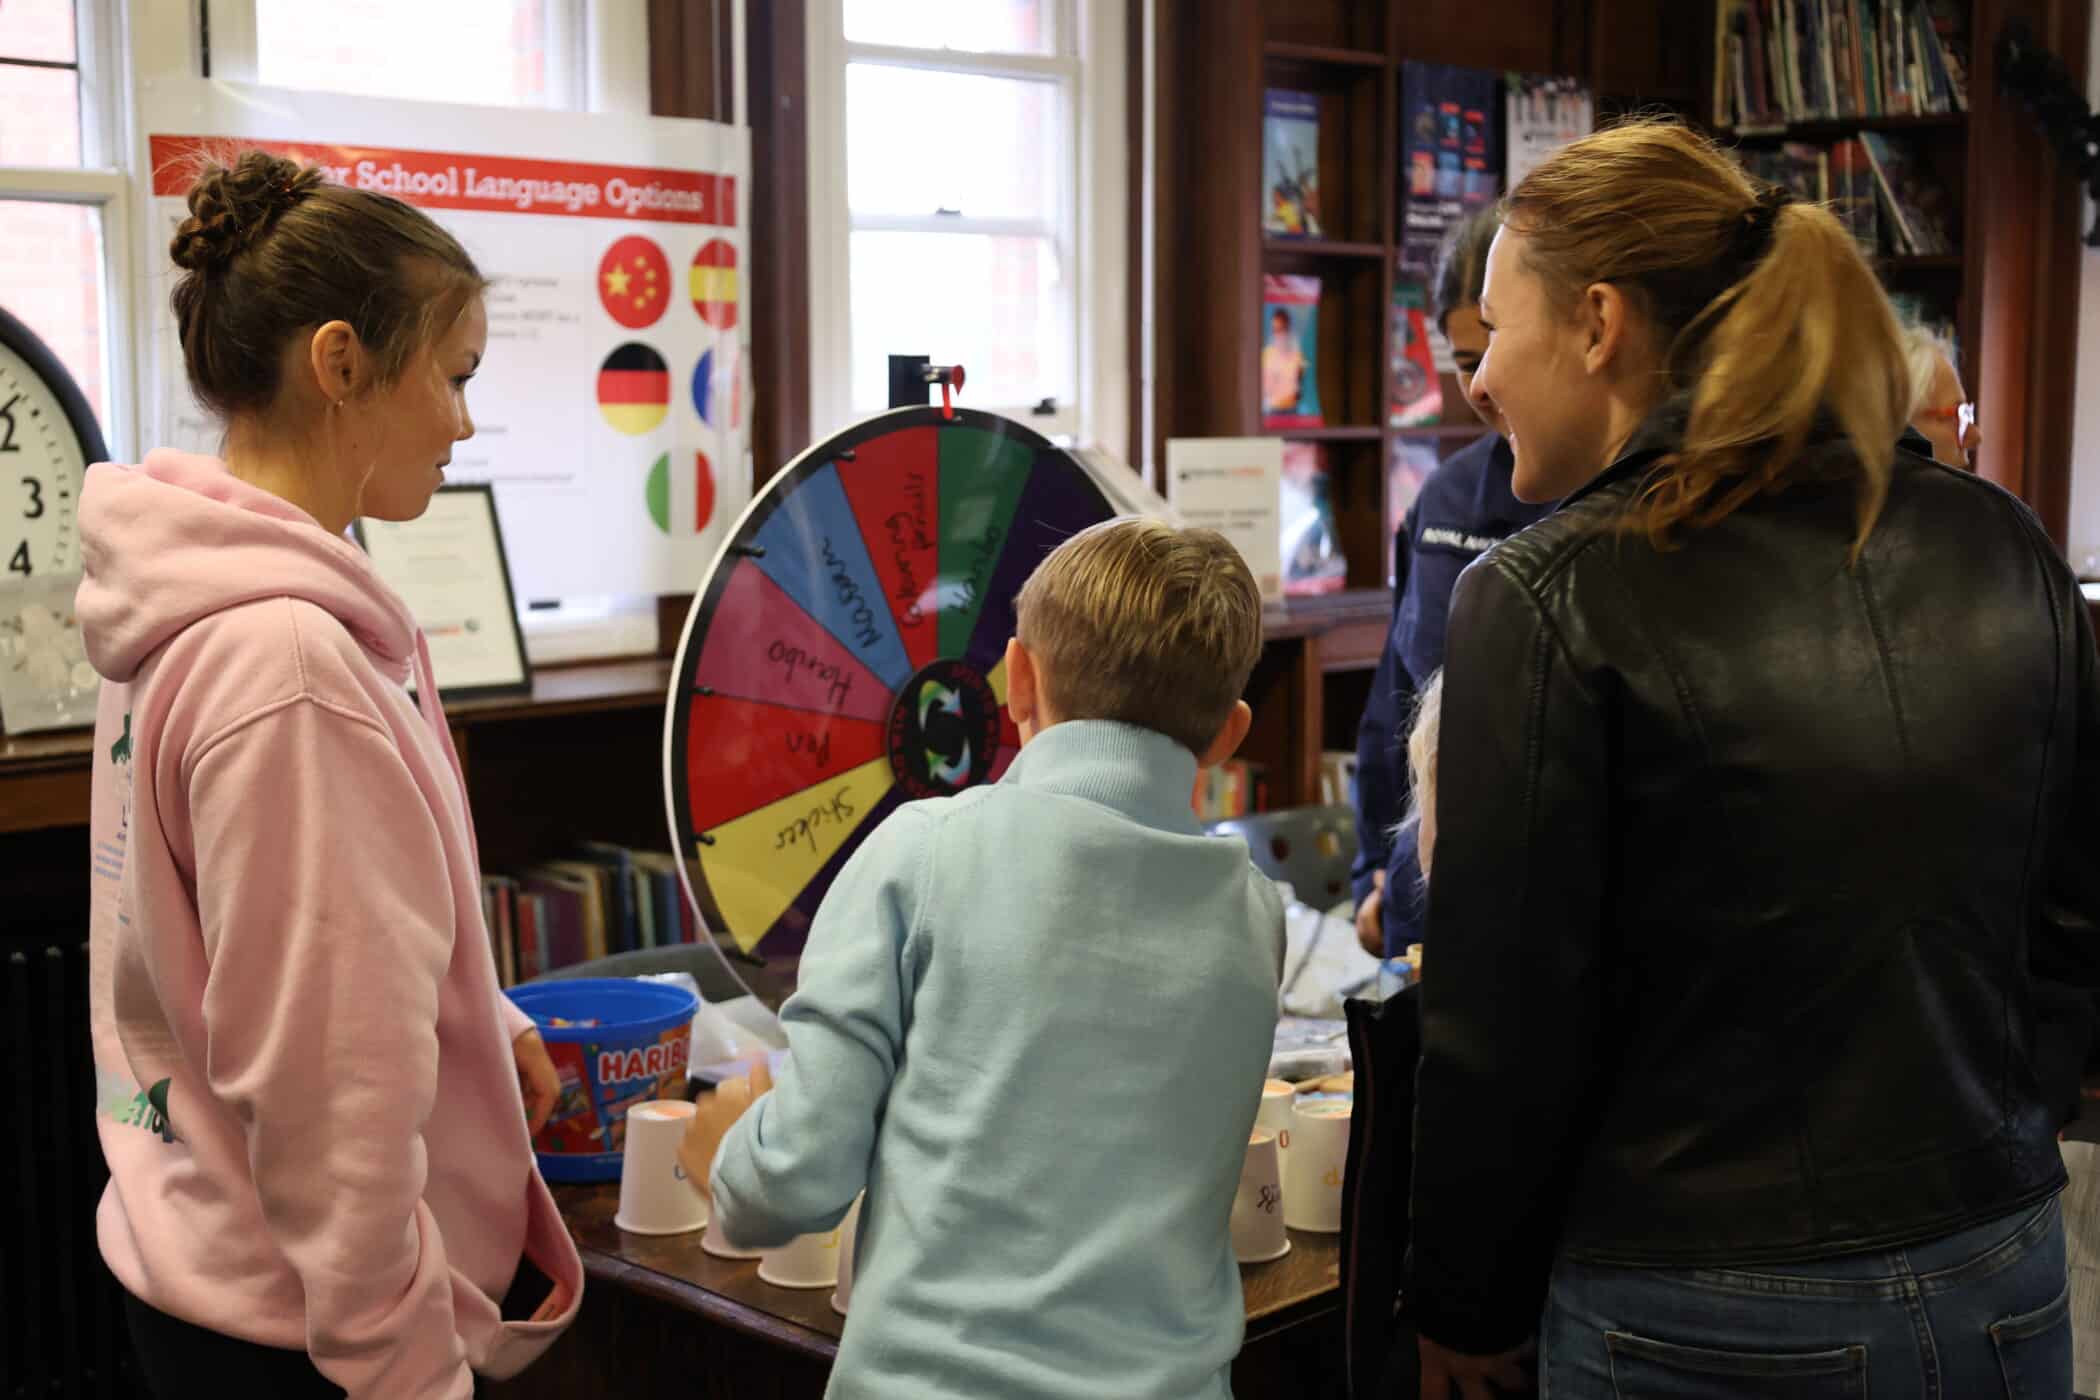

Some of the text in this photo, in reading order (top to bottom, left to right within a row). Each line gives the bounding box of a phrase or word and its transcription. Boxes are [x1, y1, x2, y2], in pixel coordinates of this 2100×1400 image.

[356, 160, 458, 197] School
[464, 168, 600, 208] Language
[605, 178, 703, 215] Options
[21, 476, 45, 519] 3
[8, 538, 33, 577] 4
